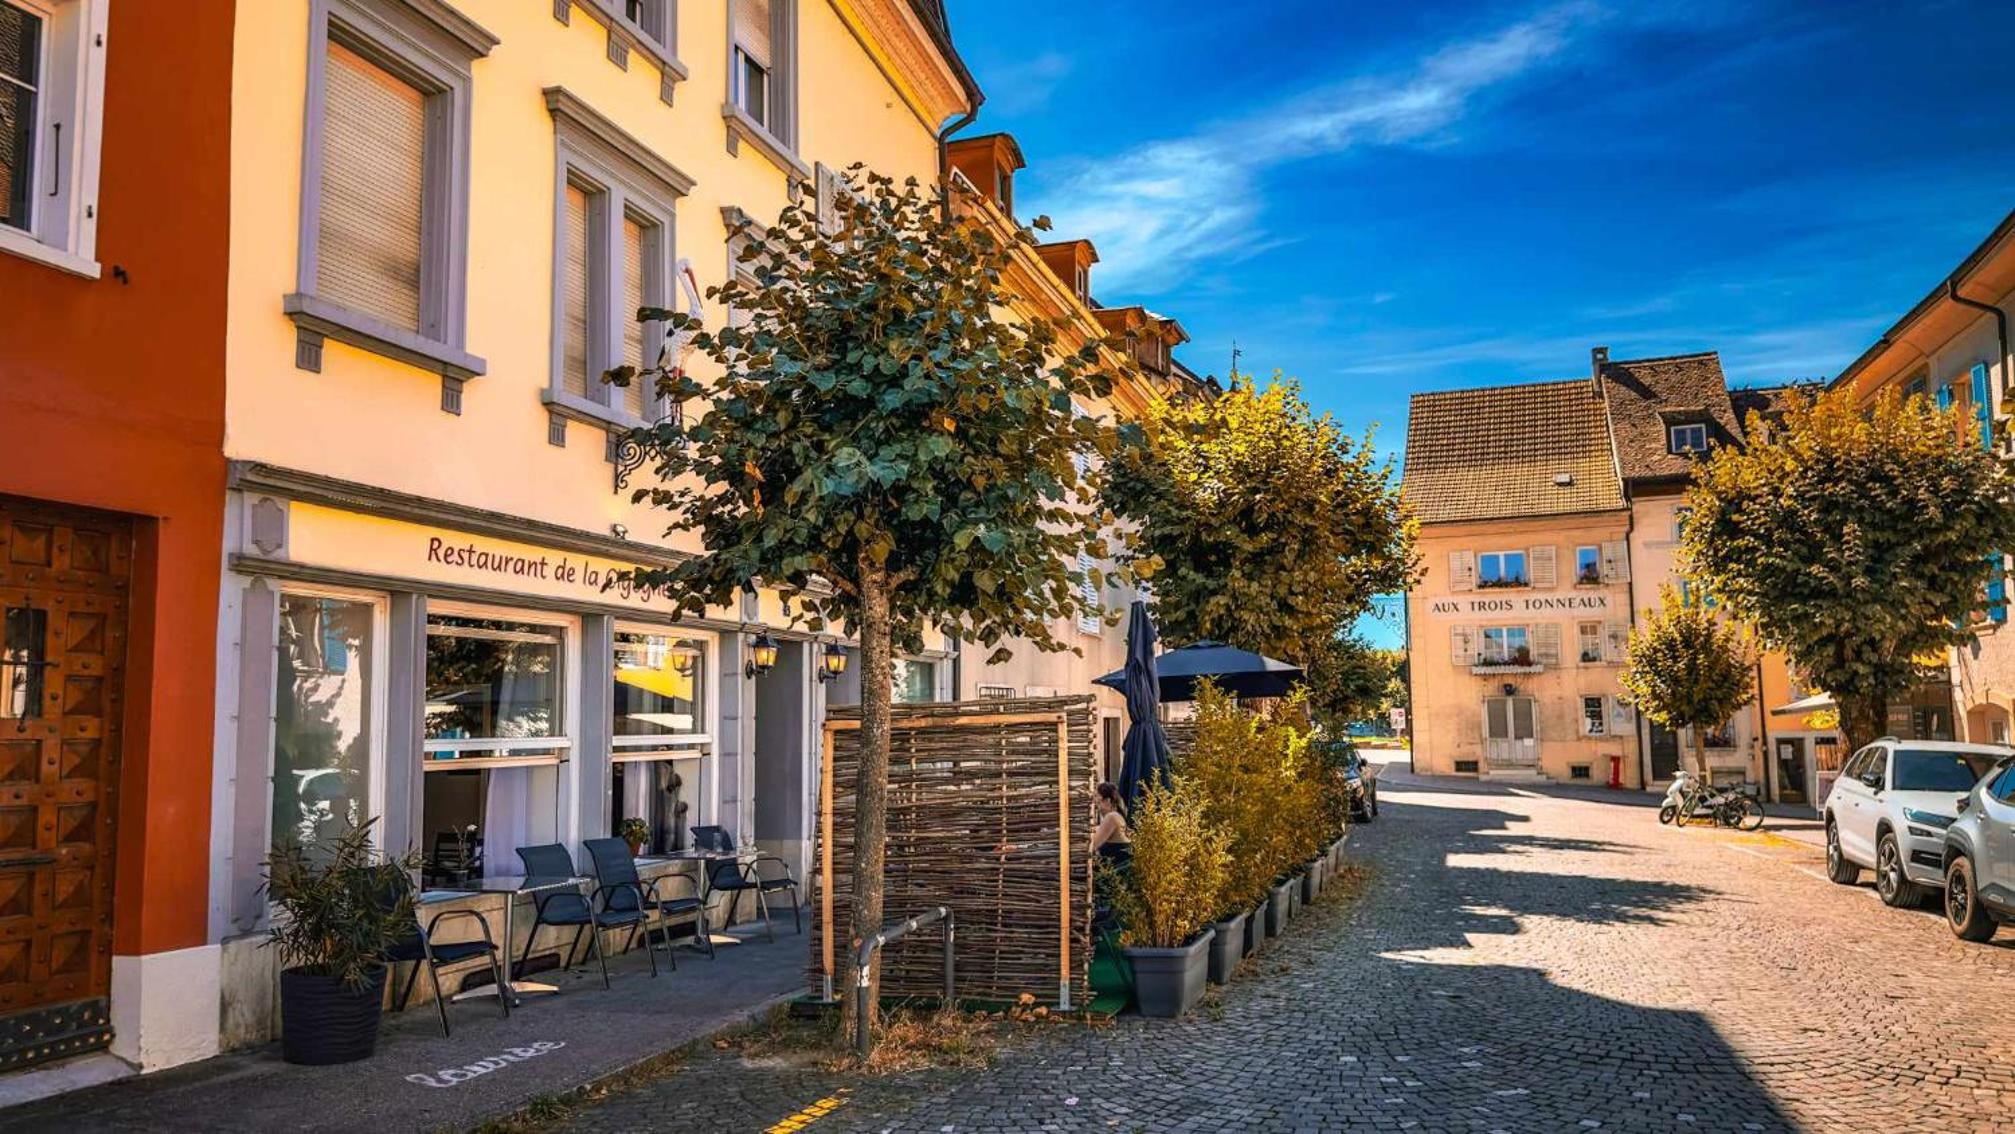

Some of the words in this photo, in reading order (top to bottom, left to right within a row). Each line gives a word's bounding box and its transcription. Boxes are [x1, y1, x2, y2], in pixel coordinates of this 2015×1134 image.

[427, 536, 547, 580] Restaurant
[555, 557, 576, 582] de
[583, 562, 599, 587] la
[1432, 603, 1460, 613] AUX
[1470, 600, 1513, 612] TROIS
[1524, 596, 1607, 611] TONNEAUX
